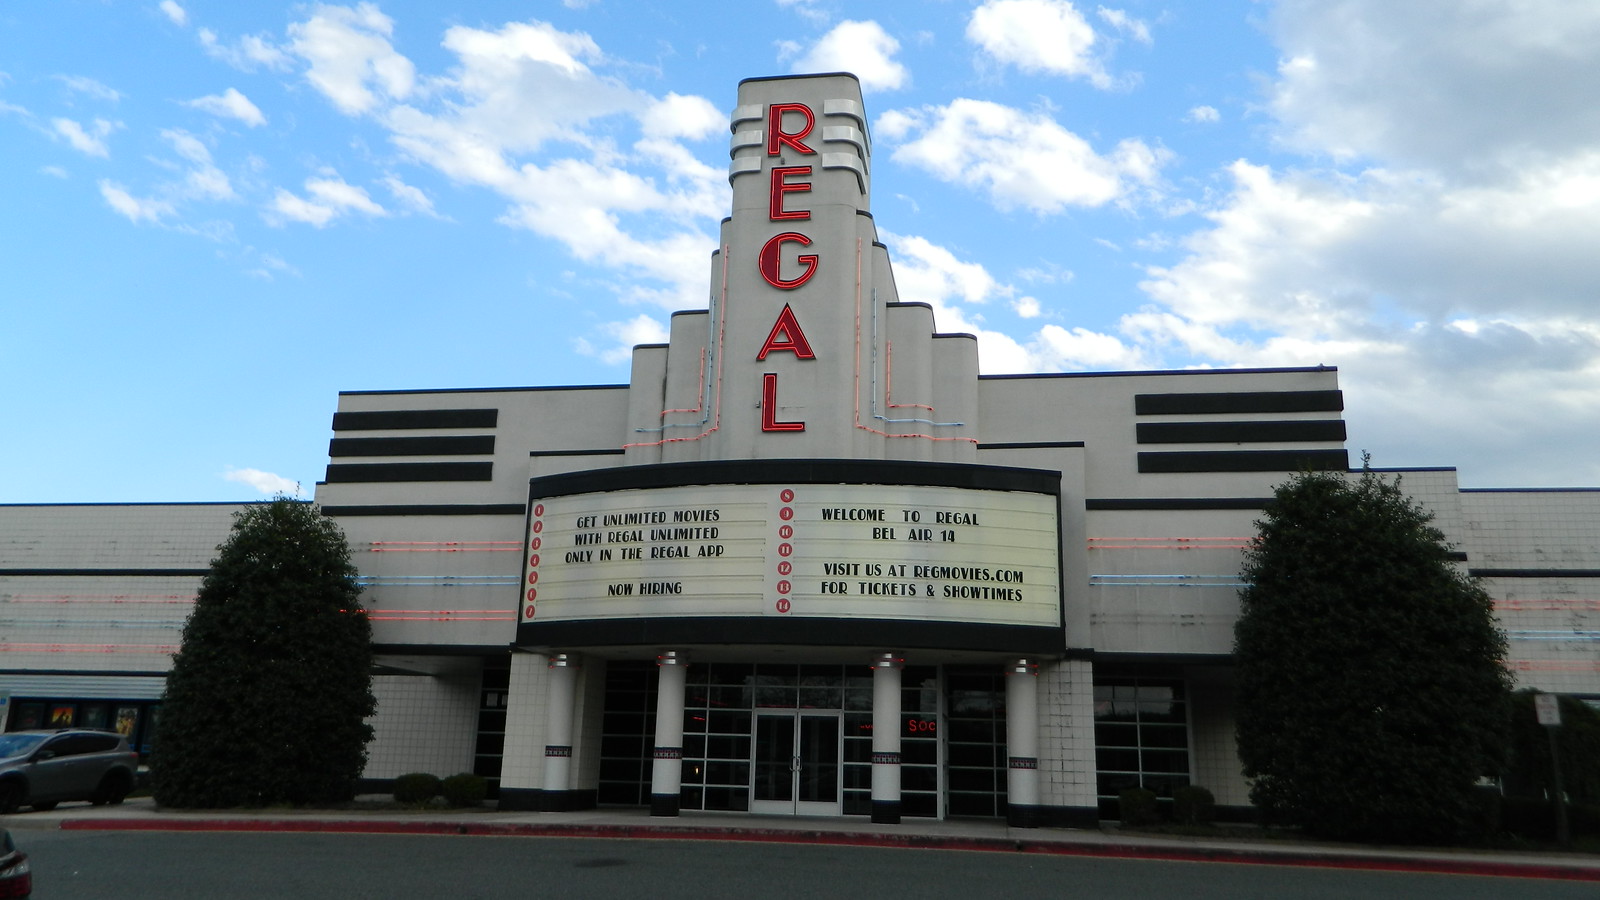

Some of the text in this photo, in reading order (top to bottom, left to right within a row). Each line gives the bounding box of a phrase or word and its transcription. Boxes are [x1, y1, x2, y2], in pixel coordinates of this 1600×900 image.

[756, 102, 819, 433] REGAL
[577, 510, 719, 528] GET UNLIMITED MOVIES
[822, 509, 979, 525] WELCOME TO REGAL
[575, 527, 718, 545] WITH REGAL UNLIMITED
[873, 528, 954, 542] BEL AIR 14
[566, 545, 723, 563] ONLY IN THE REGAL APP
[824, 563, 1023, 583] VISIT US AT REGMOVIES.COM
[608, 582, 681, 596] NOW HIRING
[822, 582, 1022, 601] FOR TICKETS & SHOWTIMES
